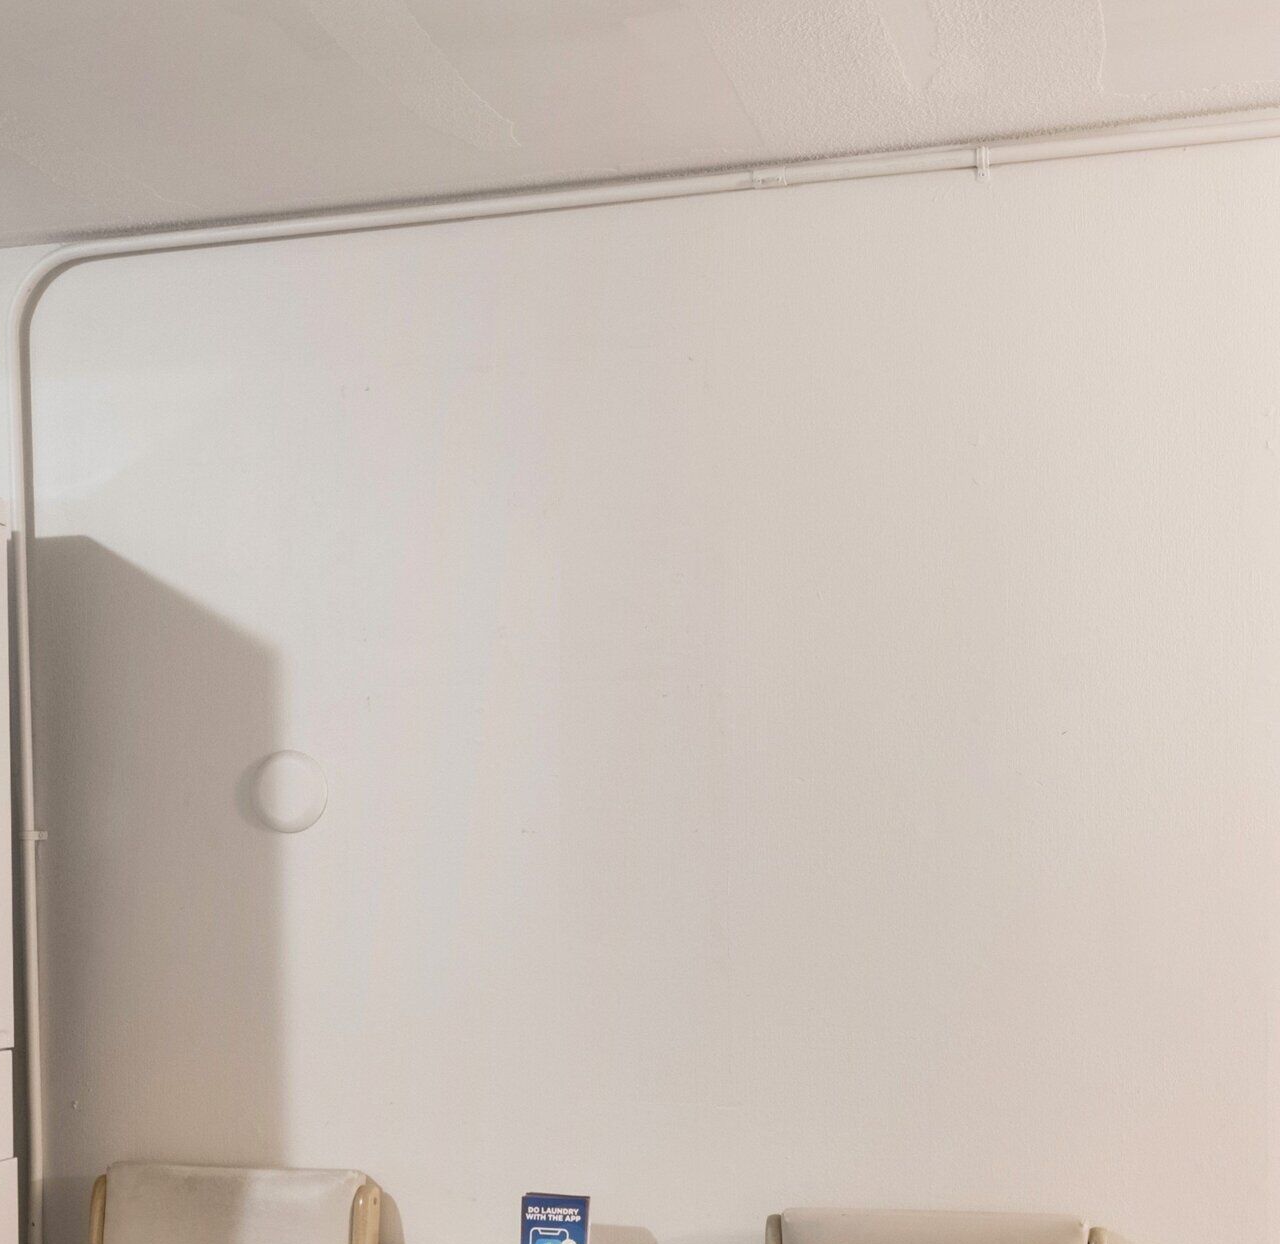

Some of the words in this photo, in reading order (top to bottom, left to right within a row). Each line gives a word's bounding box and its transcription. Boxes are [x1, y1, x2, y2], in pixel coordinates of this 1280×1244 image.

[528, 1206, 539, 1214] DO
[541, 1207, 579, 1215] LAUNDRY
[525, 1213, 547, 1221] WITH
[548, 1214, 563, 1222] THE
[564, 1215, 581, 1223] APP
